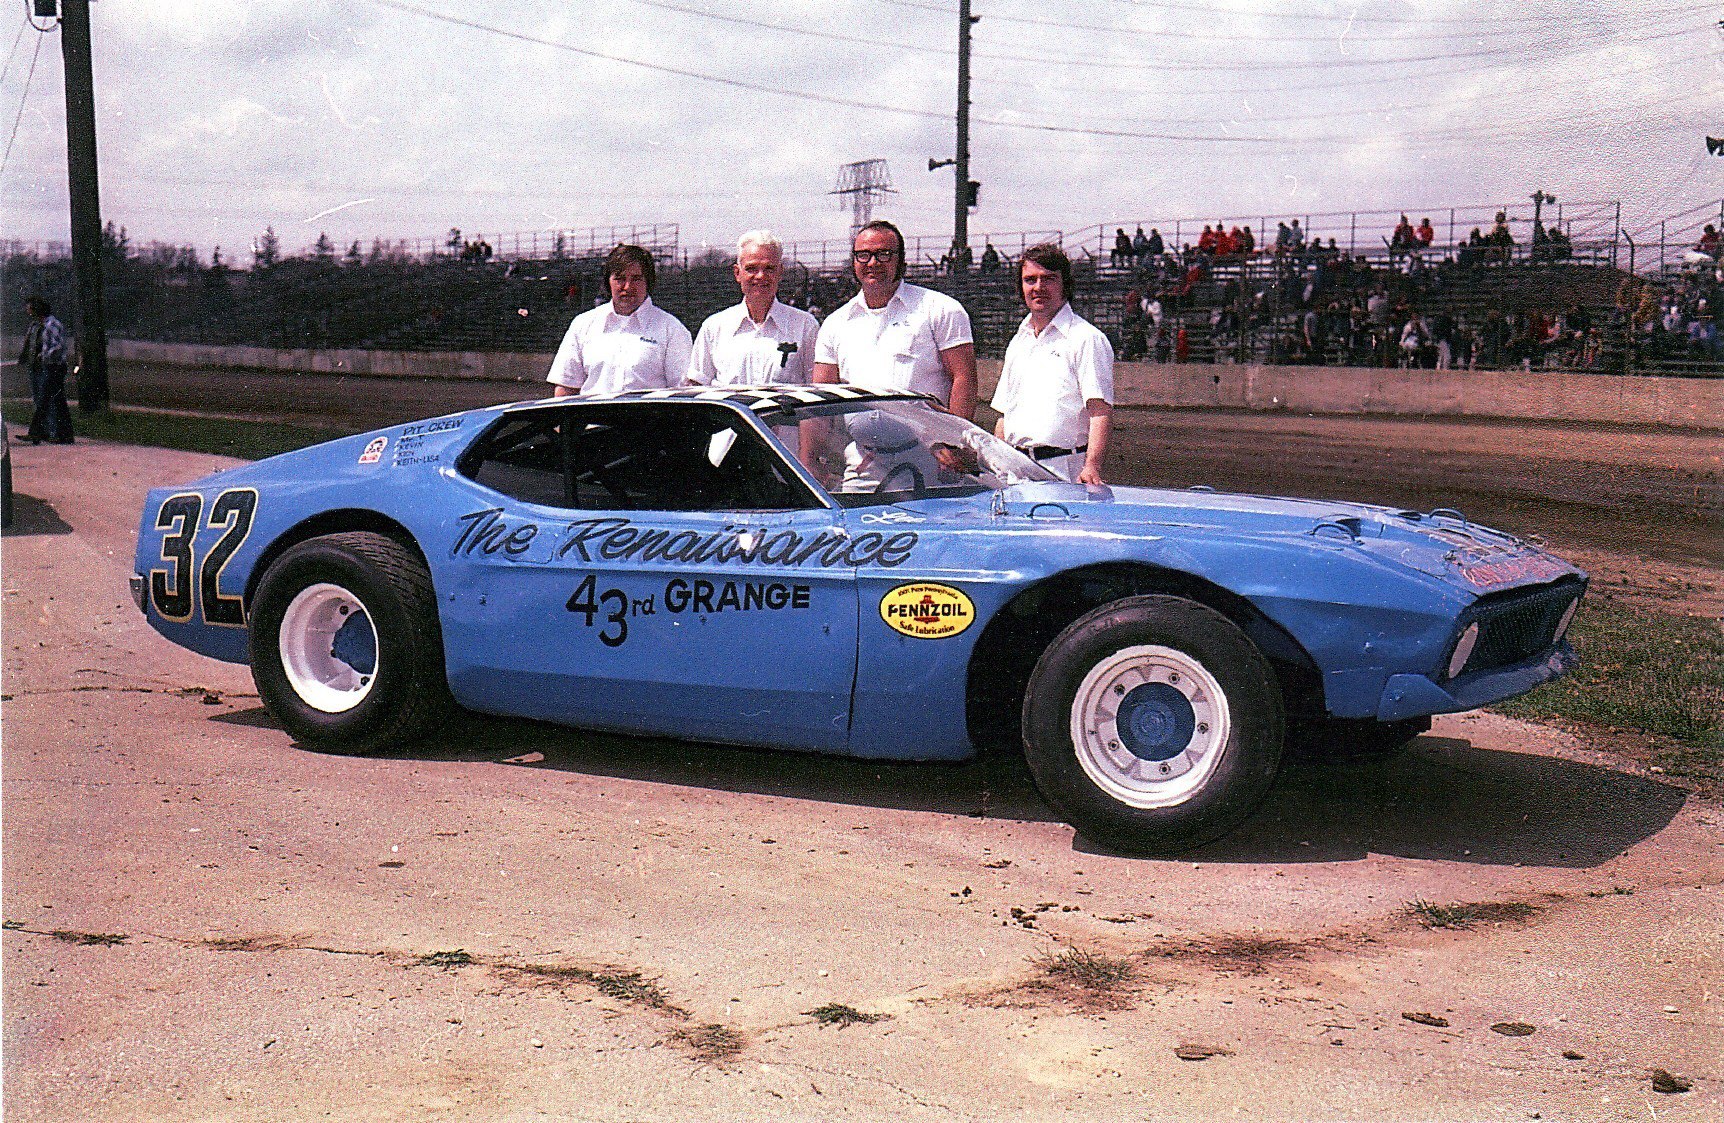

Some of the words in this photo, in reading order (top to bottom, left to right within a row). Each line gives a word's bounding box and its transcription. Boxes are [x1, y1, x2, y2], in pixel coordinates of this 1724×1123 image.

[403, 425, 424, 436] PIT
[428, 419, 464, 432] CREW
[452, 507, 538, 556] The
[150, 487, 259, 628] 32
[664, 578, 810, 614] GRANGE
[887, 603, 967, 618] PENNZOIL
[899, 620, 915, 632] Safe
[915, 624, 955, 635] Lubrication
